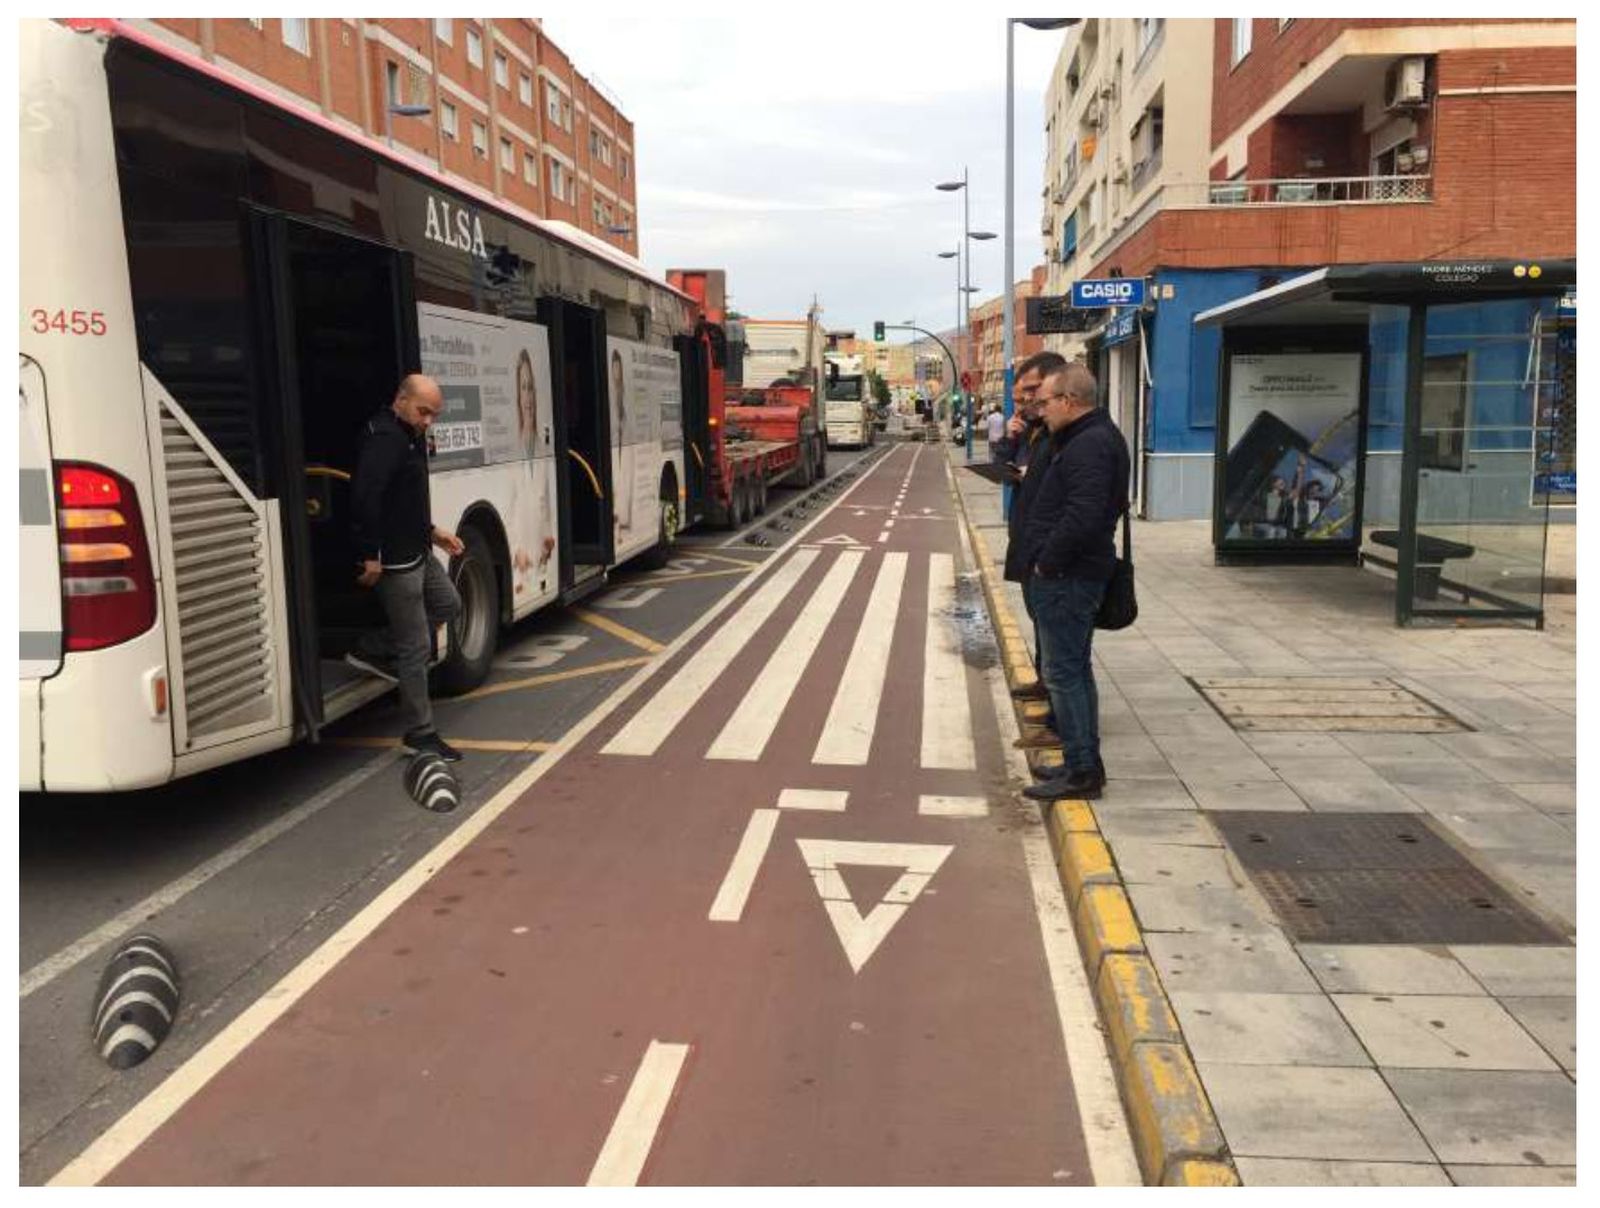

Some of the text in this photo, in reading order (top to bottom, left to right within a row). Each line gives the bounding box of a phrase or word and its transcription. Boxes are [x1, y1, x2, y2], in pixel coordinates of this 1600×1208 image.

[424, 195, 488, 259] ALSA
[1422, 264, 1450, 273] PADRE
[1081, 282, 1132, 298] CASIO
[32, 308, 106, 336] 3455
